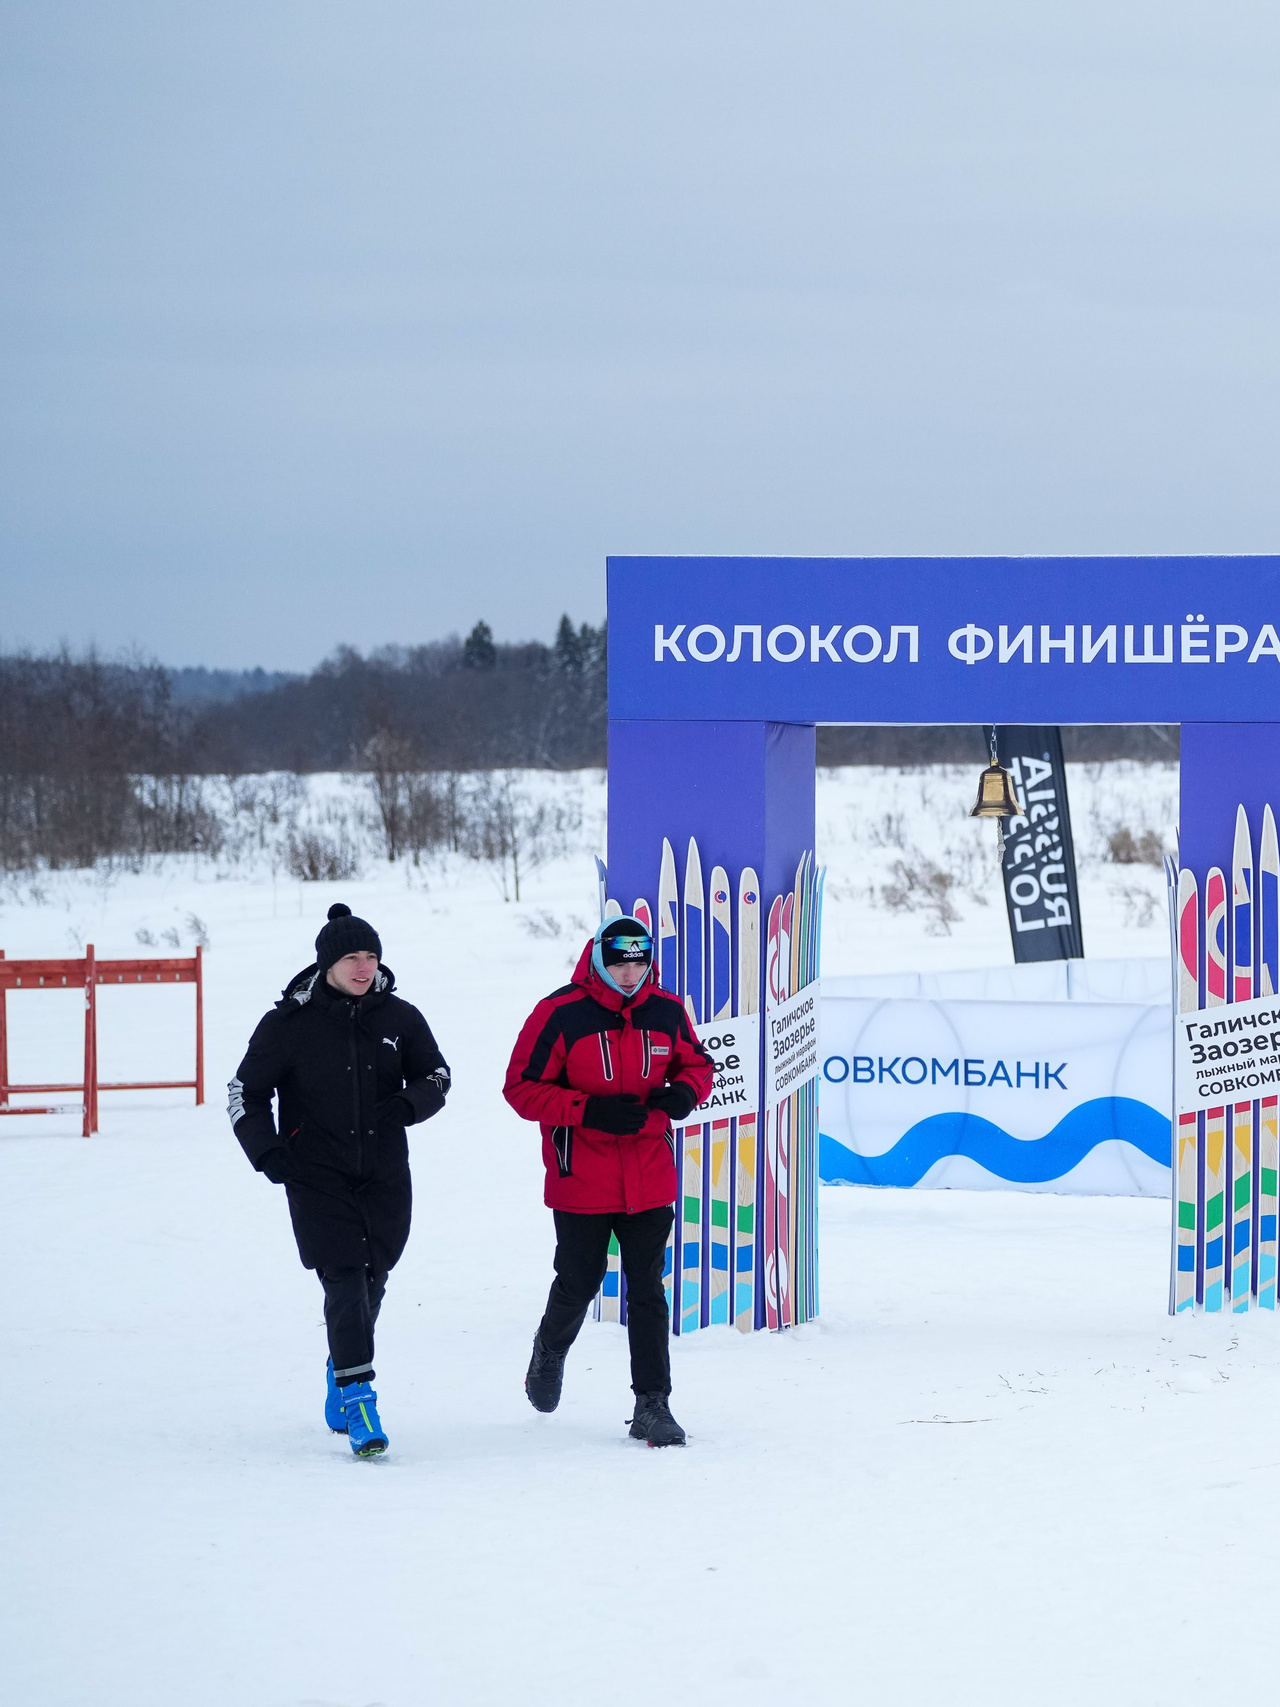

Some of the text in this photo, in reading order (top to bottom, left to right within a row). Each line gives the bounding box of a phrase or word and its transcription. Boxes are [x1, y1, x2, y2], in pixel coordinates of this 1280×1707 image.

[654, 624, 919, 663] КОЛОКОЛ
[771, 997, 814, 1037] Галичское
[773, 1017, 815, 1060] Заозерье
[775, 1051, 817, 1091] СОВКОМБАНК
[821, 1055, 1068, 1090] ОВКОМБАНК
[1195, 1058, 1256, 1079] лыжный
